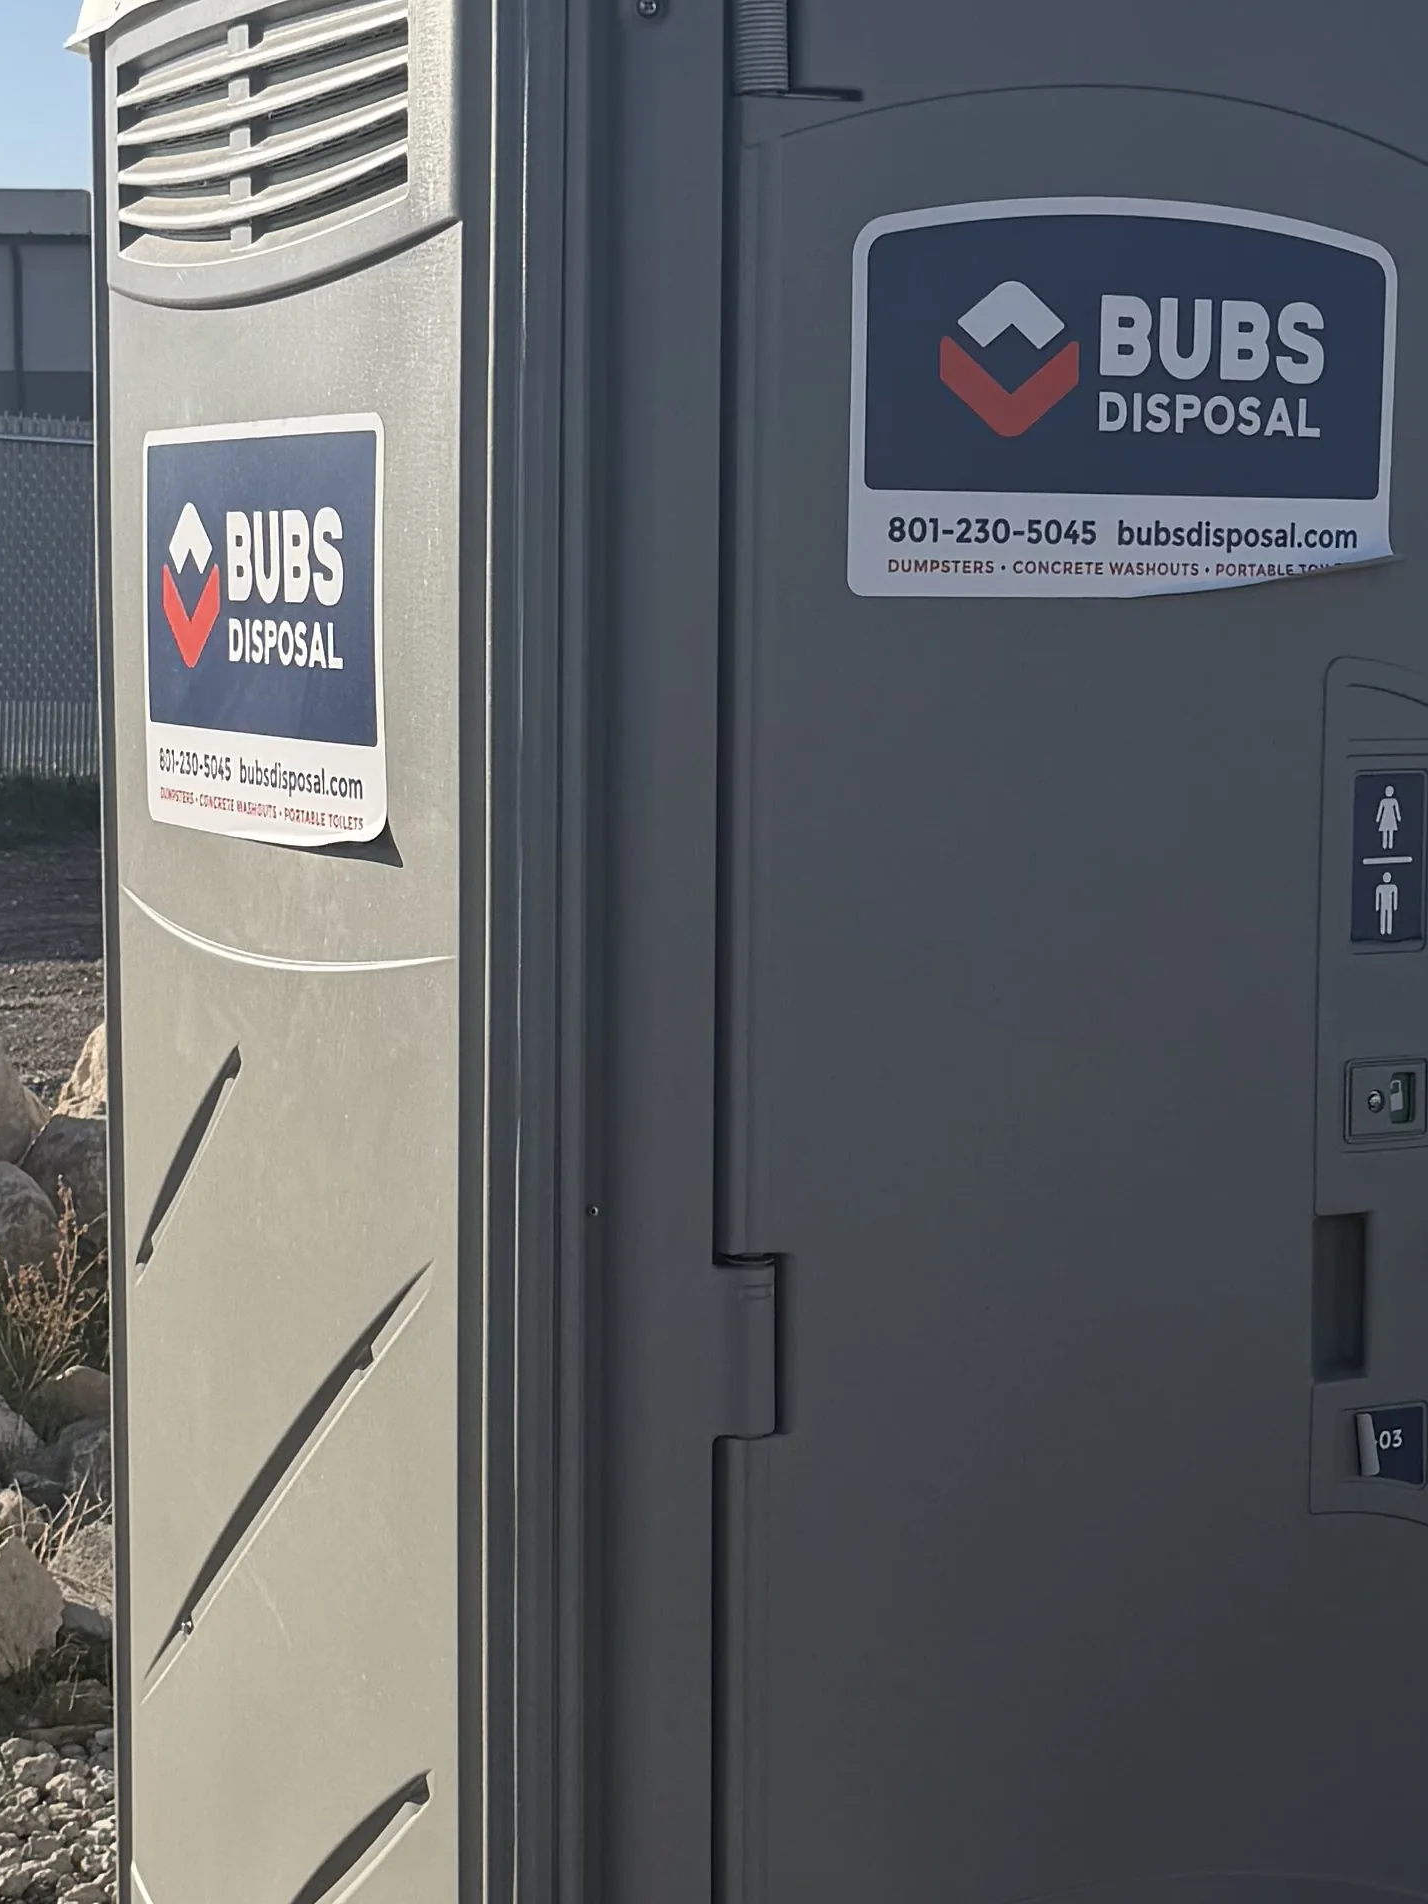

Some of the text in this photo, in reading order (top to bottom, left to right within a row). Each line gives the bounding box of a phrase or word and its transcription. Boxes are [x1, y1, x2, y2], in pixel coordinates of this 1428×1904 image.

[1098, 293, 1326, 385] BUBS
[1097, 390, 1321, 438] DISPOSAL
[226, 506, 344, 607] BUBS
[887, 516, 1358, 553] 801-230-5045 bubsdisposal.com
[887, 558, 995, 574] DUMPSTERS
[1012, 559, 1104, 576] CONCRETE
[1108, 561, 1199, 577] WASHOUTS
[1215, 562, 1294, 577] PORTABLE
[228, 617, 344, 670] DISPOSAL
[159, 747, 363, 800] 801-230-5045 bubsdisposal.com
[160, 786, 364, 831] DUMPSTERS CONCRETE WASHOUTS PORTABLE TOILETS
